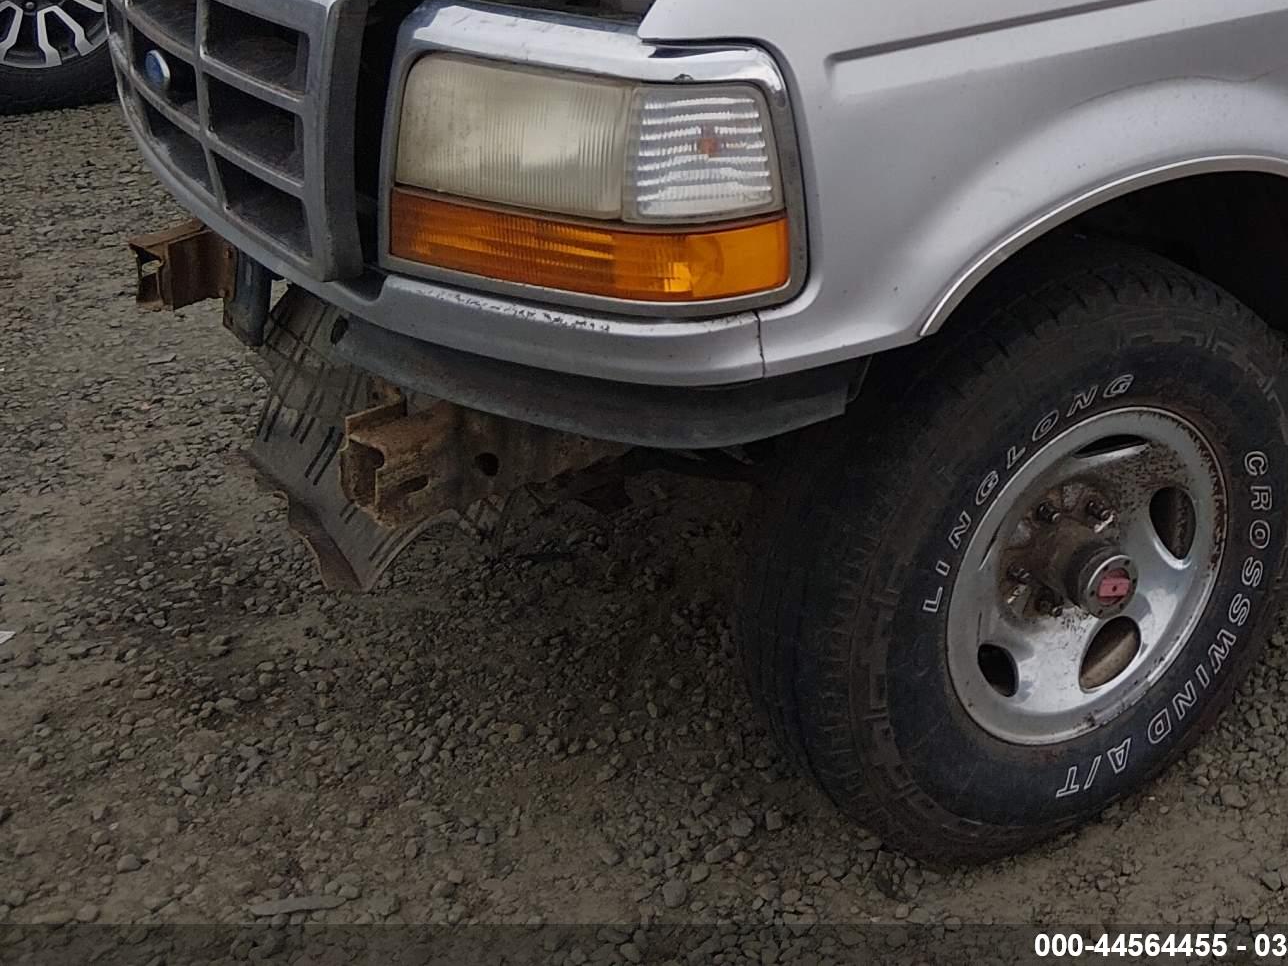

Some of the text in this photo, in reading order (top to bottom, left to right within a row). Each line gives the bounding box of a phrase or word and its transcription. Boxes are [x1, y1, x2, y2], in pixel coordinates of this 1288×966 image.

[921, 372, 1136, 615] LINGLONG
[1055, 449, 1273, 800] CROSSWIND A/T
